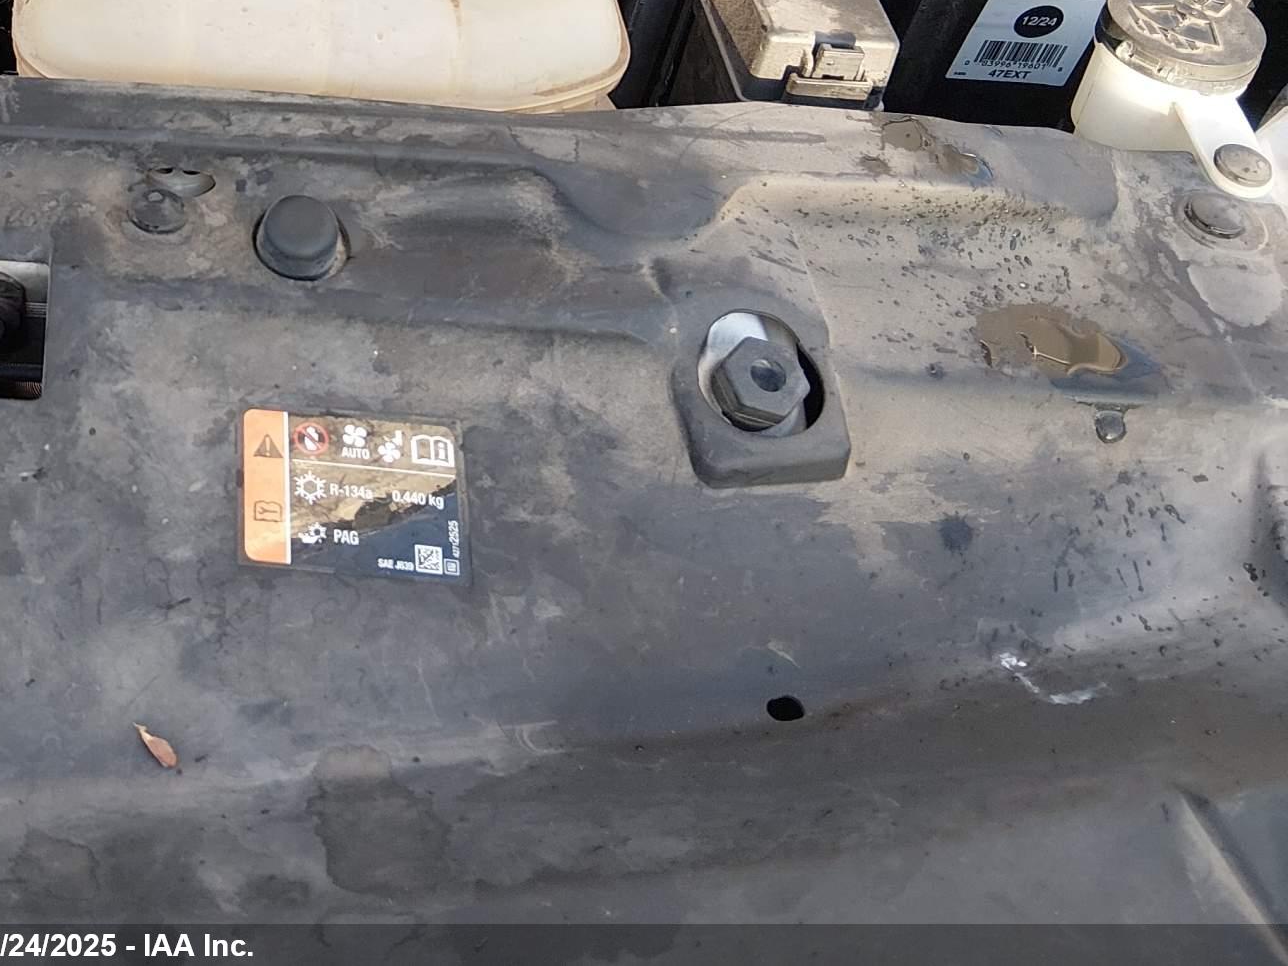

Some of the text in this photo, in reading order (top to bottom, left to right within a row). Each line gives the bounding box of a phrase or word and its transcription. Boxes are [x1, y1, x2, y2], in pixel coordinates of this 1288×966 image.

[1022, 16, 1058, 26] 12/24
[988, 69, 1032, 79] 47EXT
[341, 447, 370, 460] AUTO
[329, 483, 444, 510] R-134a 0.440 kg
[333, 529, 360, 546] PAG
